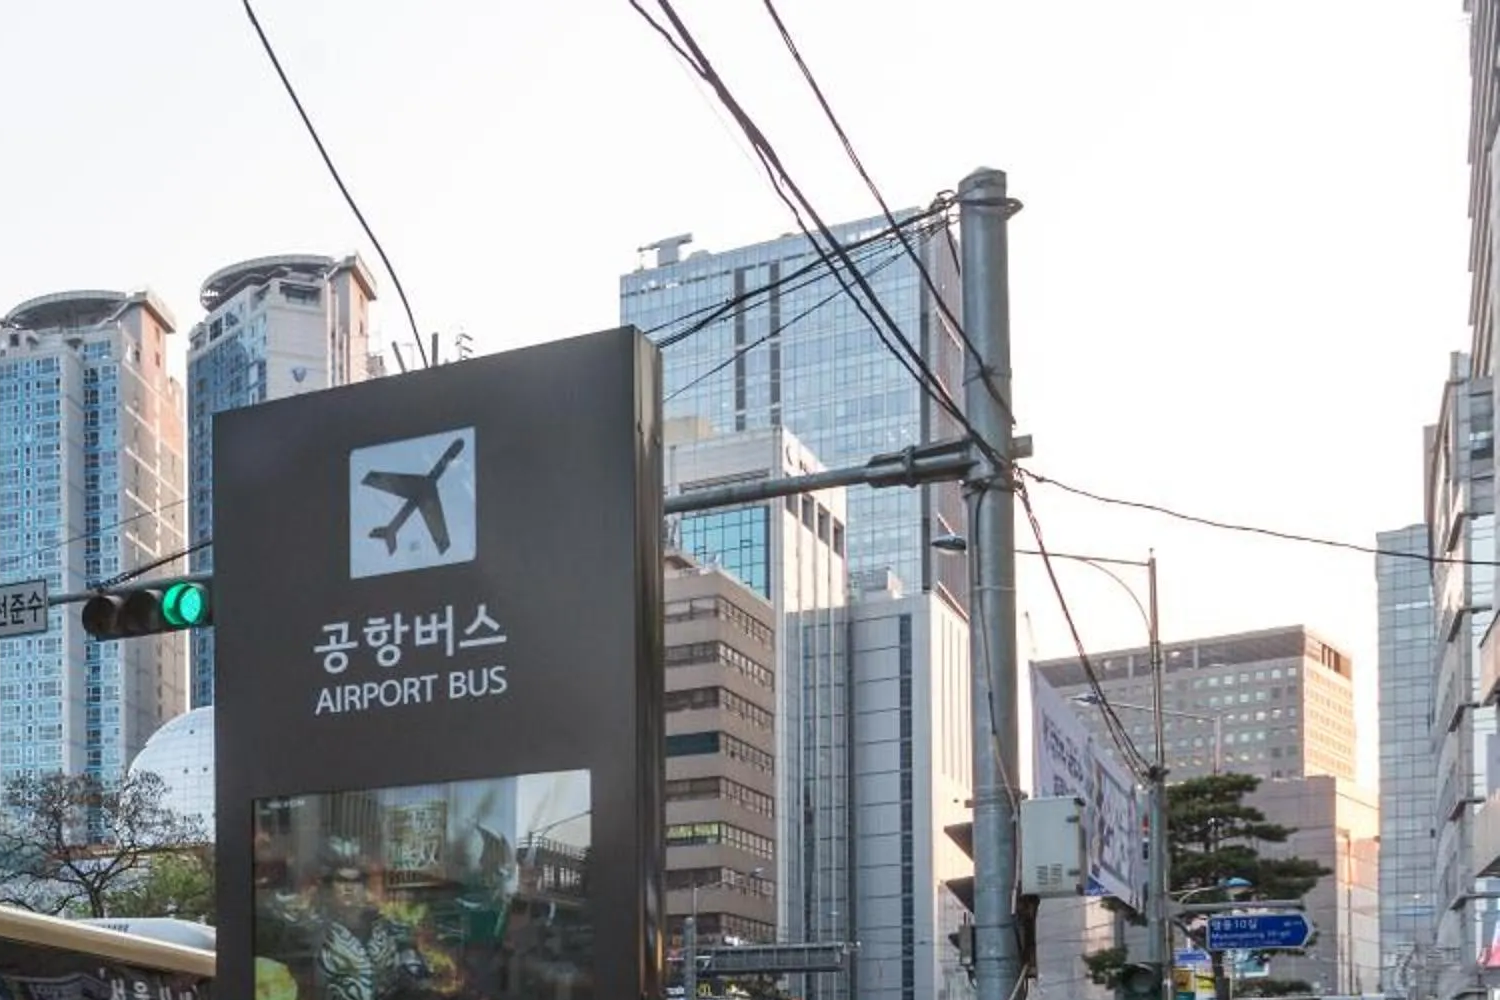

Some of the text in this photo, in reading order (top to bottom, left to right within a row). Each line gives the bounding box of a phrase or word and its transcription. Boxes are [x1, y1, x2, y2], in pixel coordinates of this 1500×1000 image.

[313, 603, 508, 675] 공항버스
[314, 665, 509, 716] AIRPORT BUS
